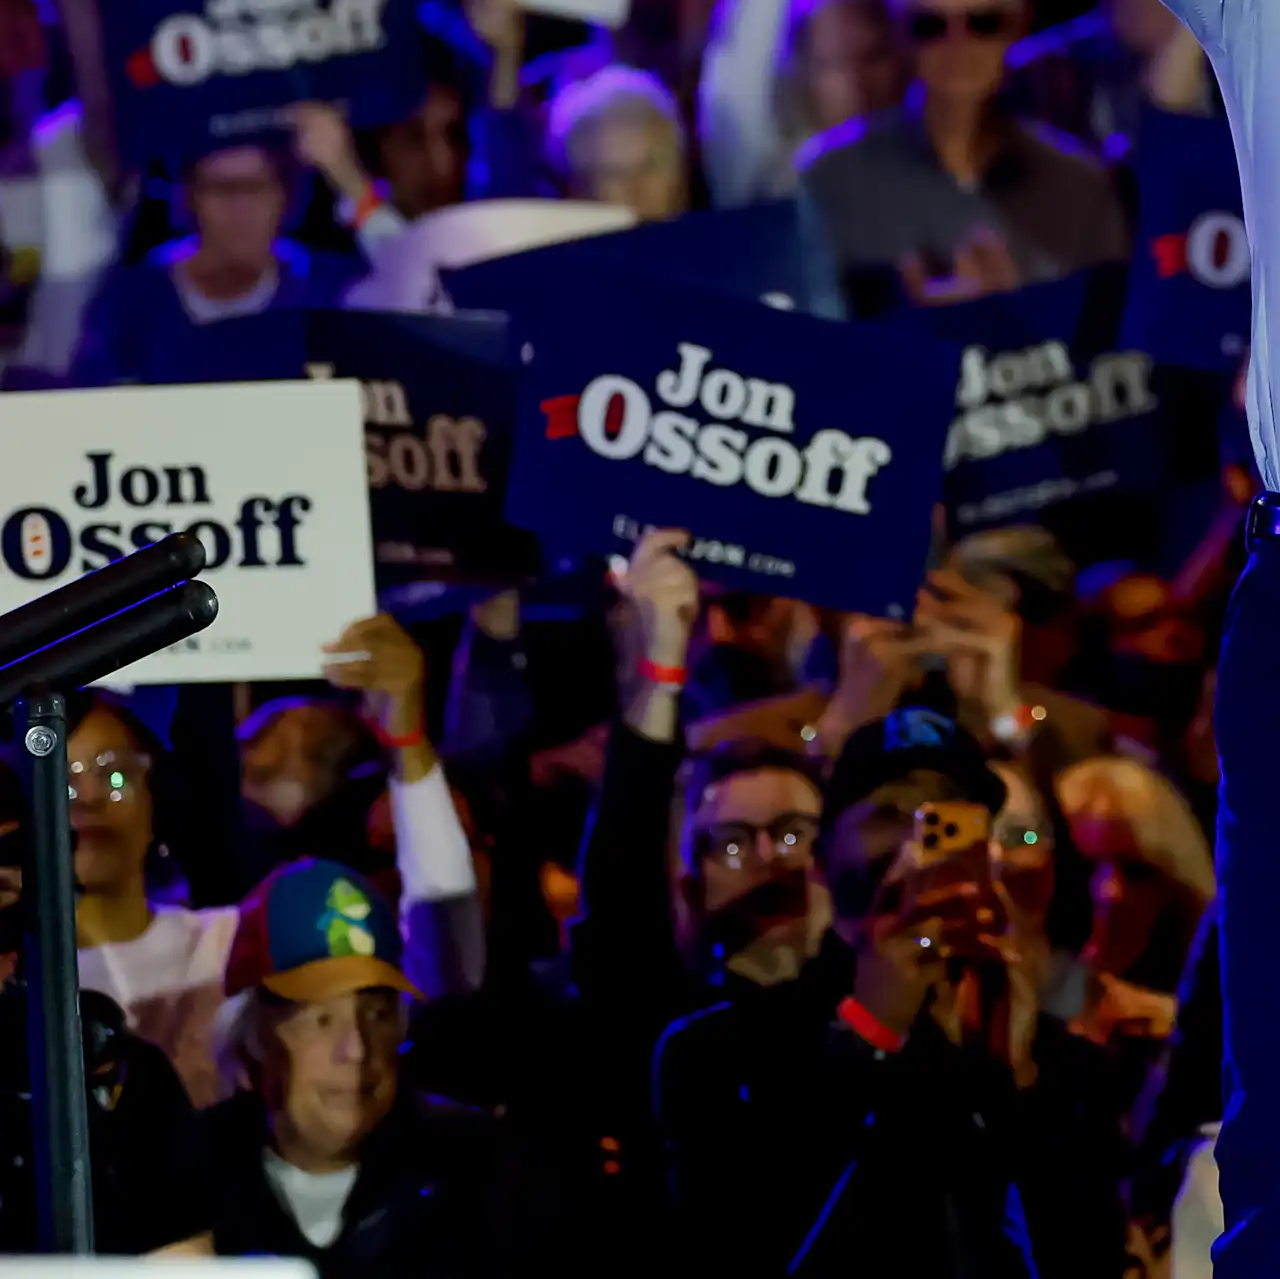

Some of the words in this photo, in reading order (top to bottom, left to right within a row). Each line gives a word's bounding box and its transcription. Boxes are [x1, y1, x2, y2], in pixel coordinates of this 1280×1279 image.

[656, 340, 796, 433] Jon
[74, 451, 211, 508] Jon
[577, 373, 892, 516] Ossoff
